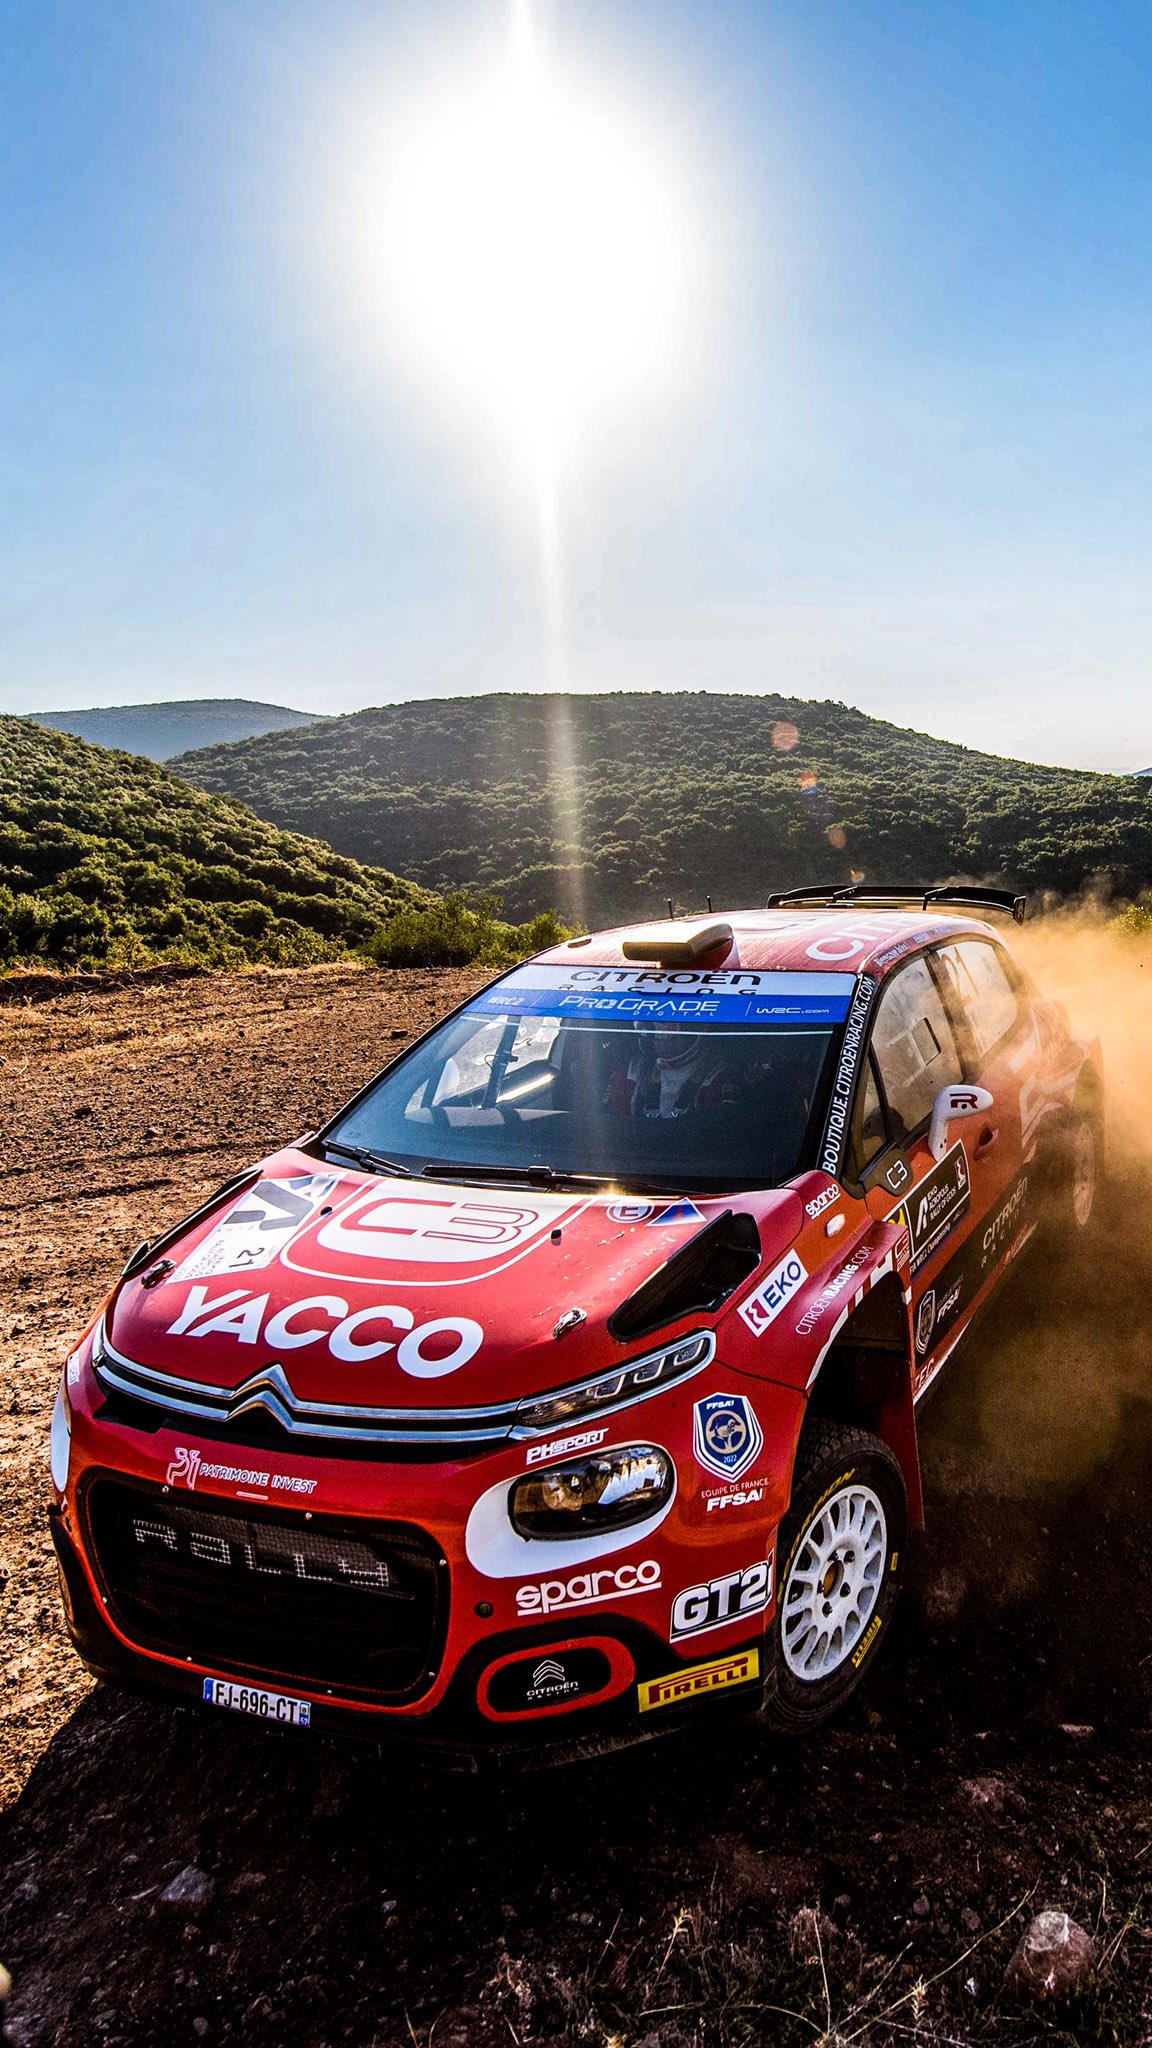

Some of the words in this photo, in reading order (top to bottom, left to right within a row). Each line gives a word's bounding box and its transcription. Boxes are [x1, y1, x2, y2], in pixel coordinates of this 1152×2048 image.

[886, 1160, 908, 1190] C3
[805, 1183, 842, 1218] sparco
[227, 1247, 266, 1269] 21
[763, 1259, 802, 1310] EKO
[795, 1246, 875, 1336] CITROENRACING.COM
[166, 1284, 485, 1380] YACCO
[200, 1462, 270, 1486] PATRIMOINE
[271, 1474, 318, 1495] INVEST
[701, 1485, 729, 1499] EQUIPE
[729, 1483, 740, 1493] DE
[741, 1477, 770, 1490] FRANCE
[516, 1559, 662, 1614] sparco
[649, 1656, 749, 1706] PIRELLI
[215, 1683, 298, 1723] FJ-696-CT
